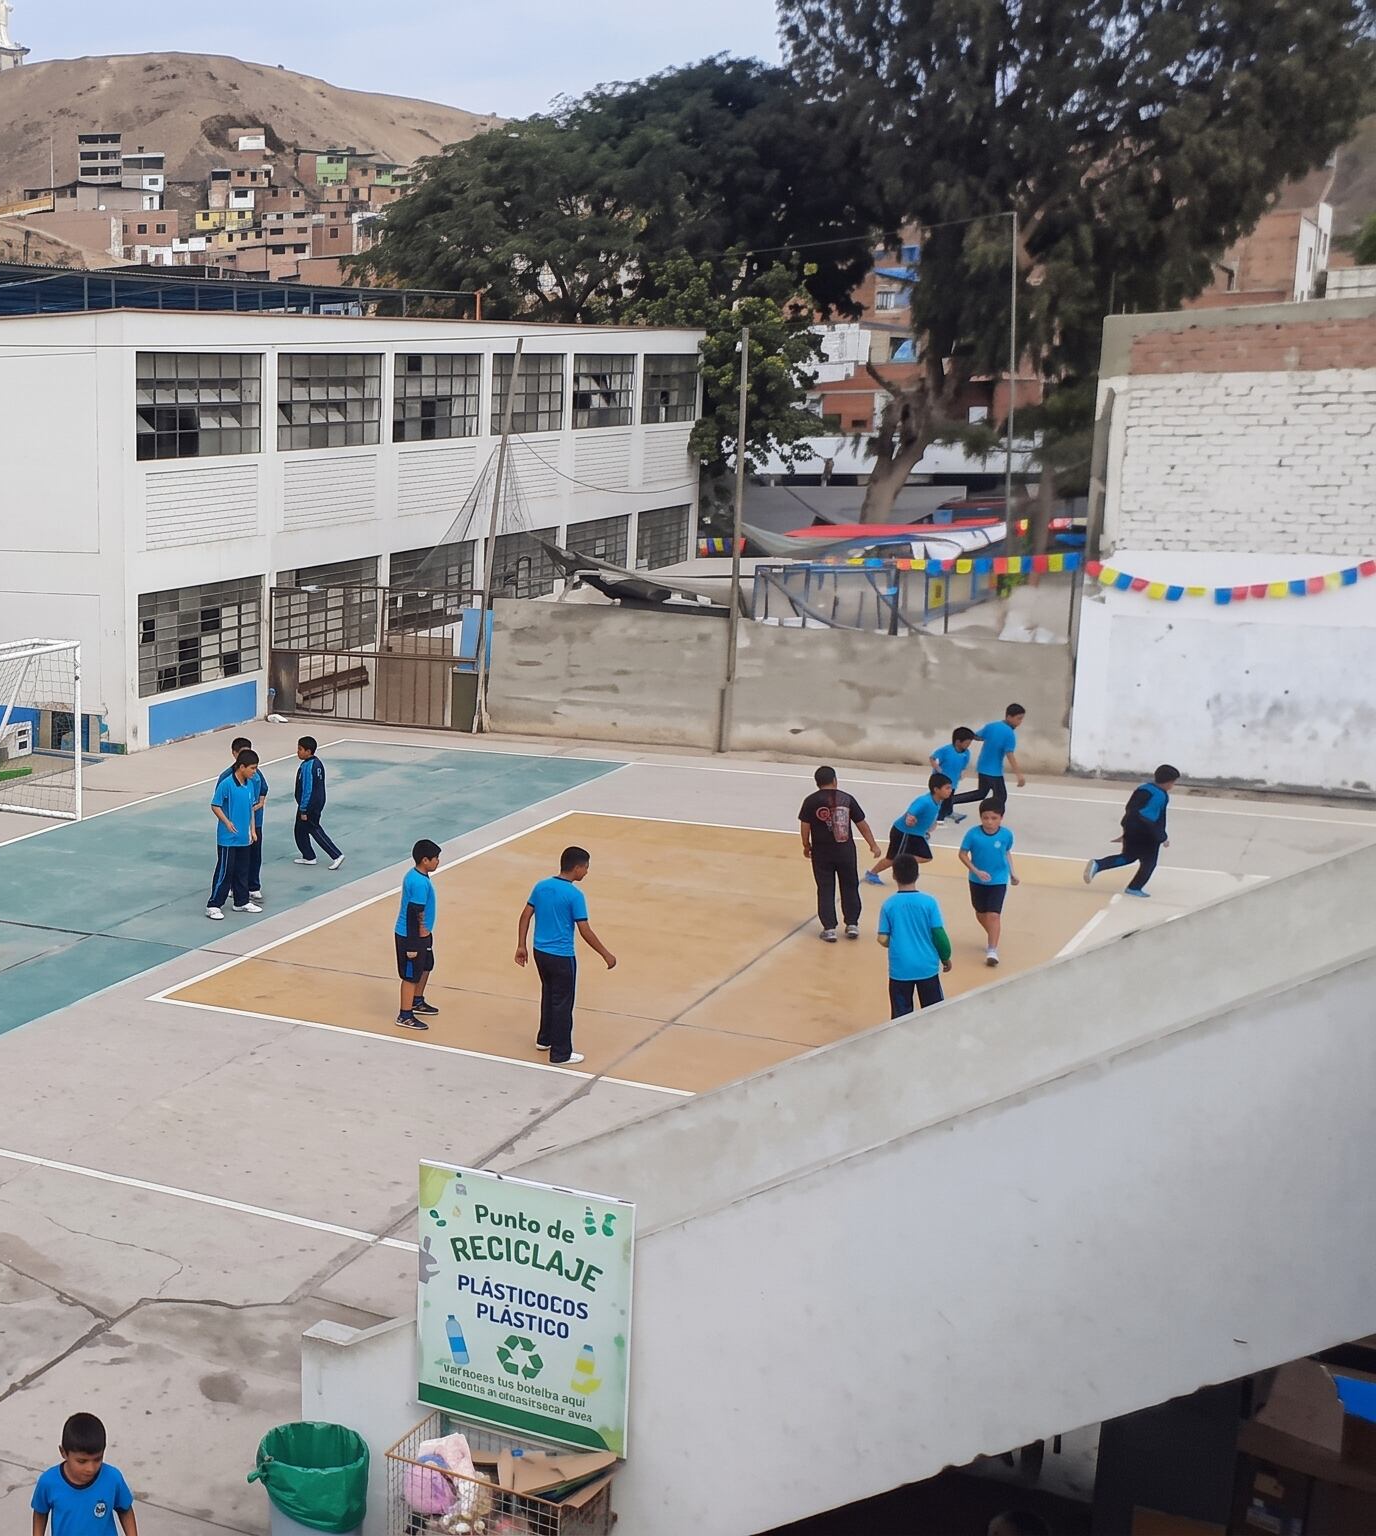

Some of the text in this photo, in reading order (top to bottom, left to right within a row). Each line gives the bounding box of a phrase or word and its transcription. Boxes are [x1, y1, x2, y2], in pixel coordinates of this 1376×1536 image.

[474, 1204, 575, 1244] Punto de
[450, 1235, 604, 1293] RECICLAJE
[476, 1302, 570, 1339] PLÁSTICO
[497, 1376, 514, 1390] tus
